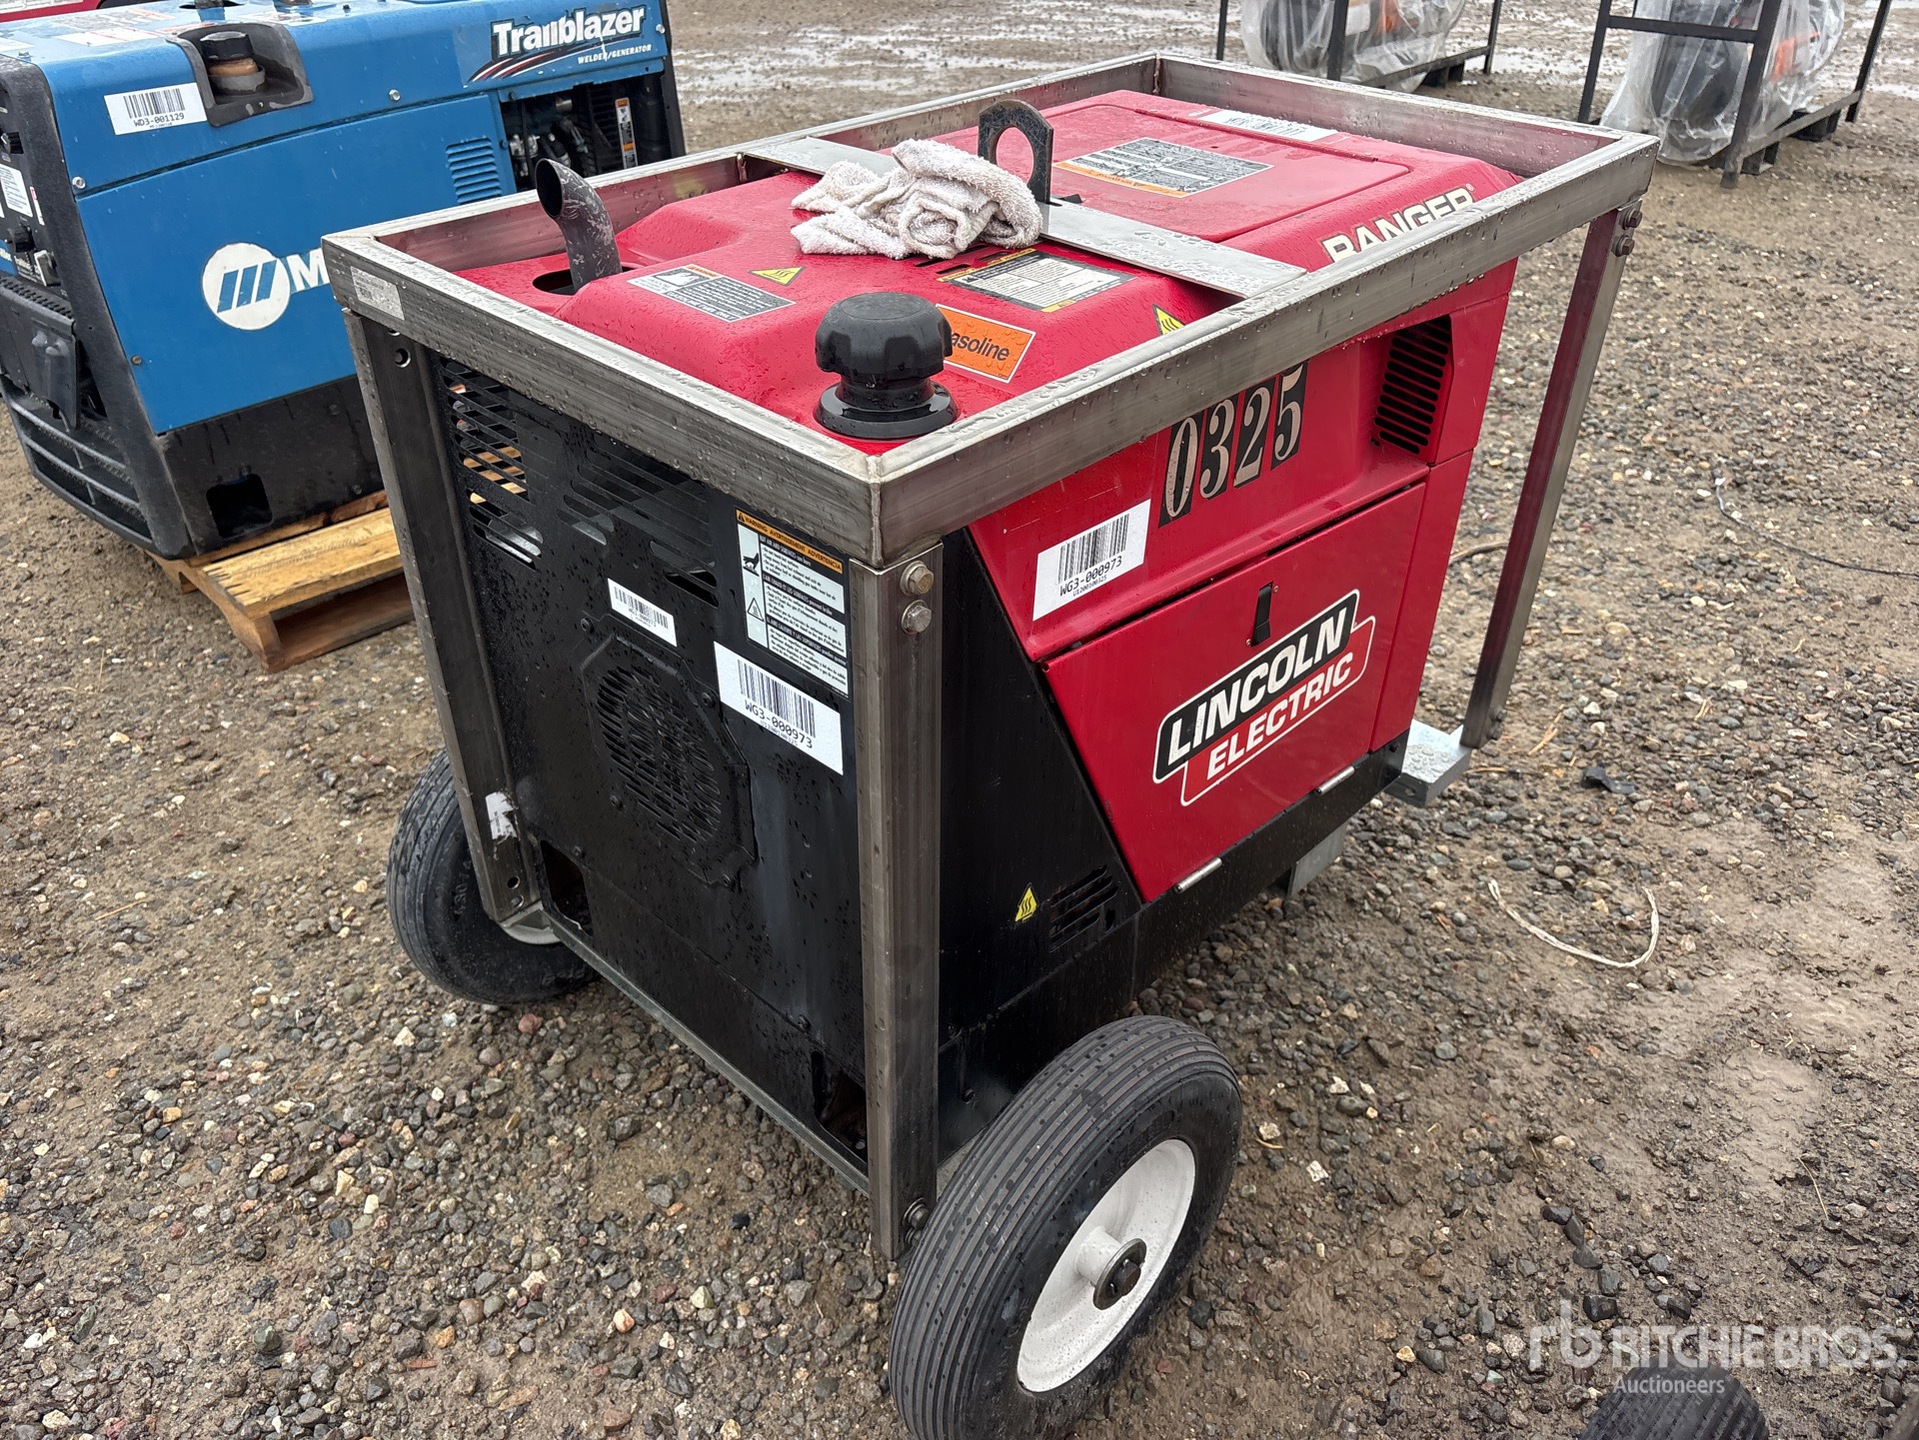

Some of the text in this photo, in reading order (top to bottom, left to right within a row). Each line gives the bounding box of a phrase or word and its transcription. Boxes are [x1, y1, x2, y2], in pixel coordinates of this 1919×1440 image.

[493, 7, 645, 55] Trailblazer
[578, 44, 652, 64] WELDER/GENERATOR
[133, 112, 184, 127] WD3-001129
[951, 332, 1010, 361] asoline
[1165, 364, 1303, 517] 0325
[1059, 555, 1123, 596] WG3-000973
[1168, 607, 1347, 766] LINCOLN
[744, 699, 813, 749] WG3-000973
[1206, 652, 1354, 781] ELECTRIC
